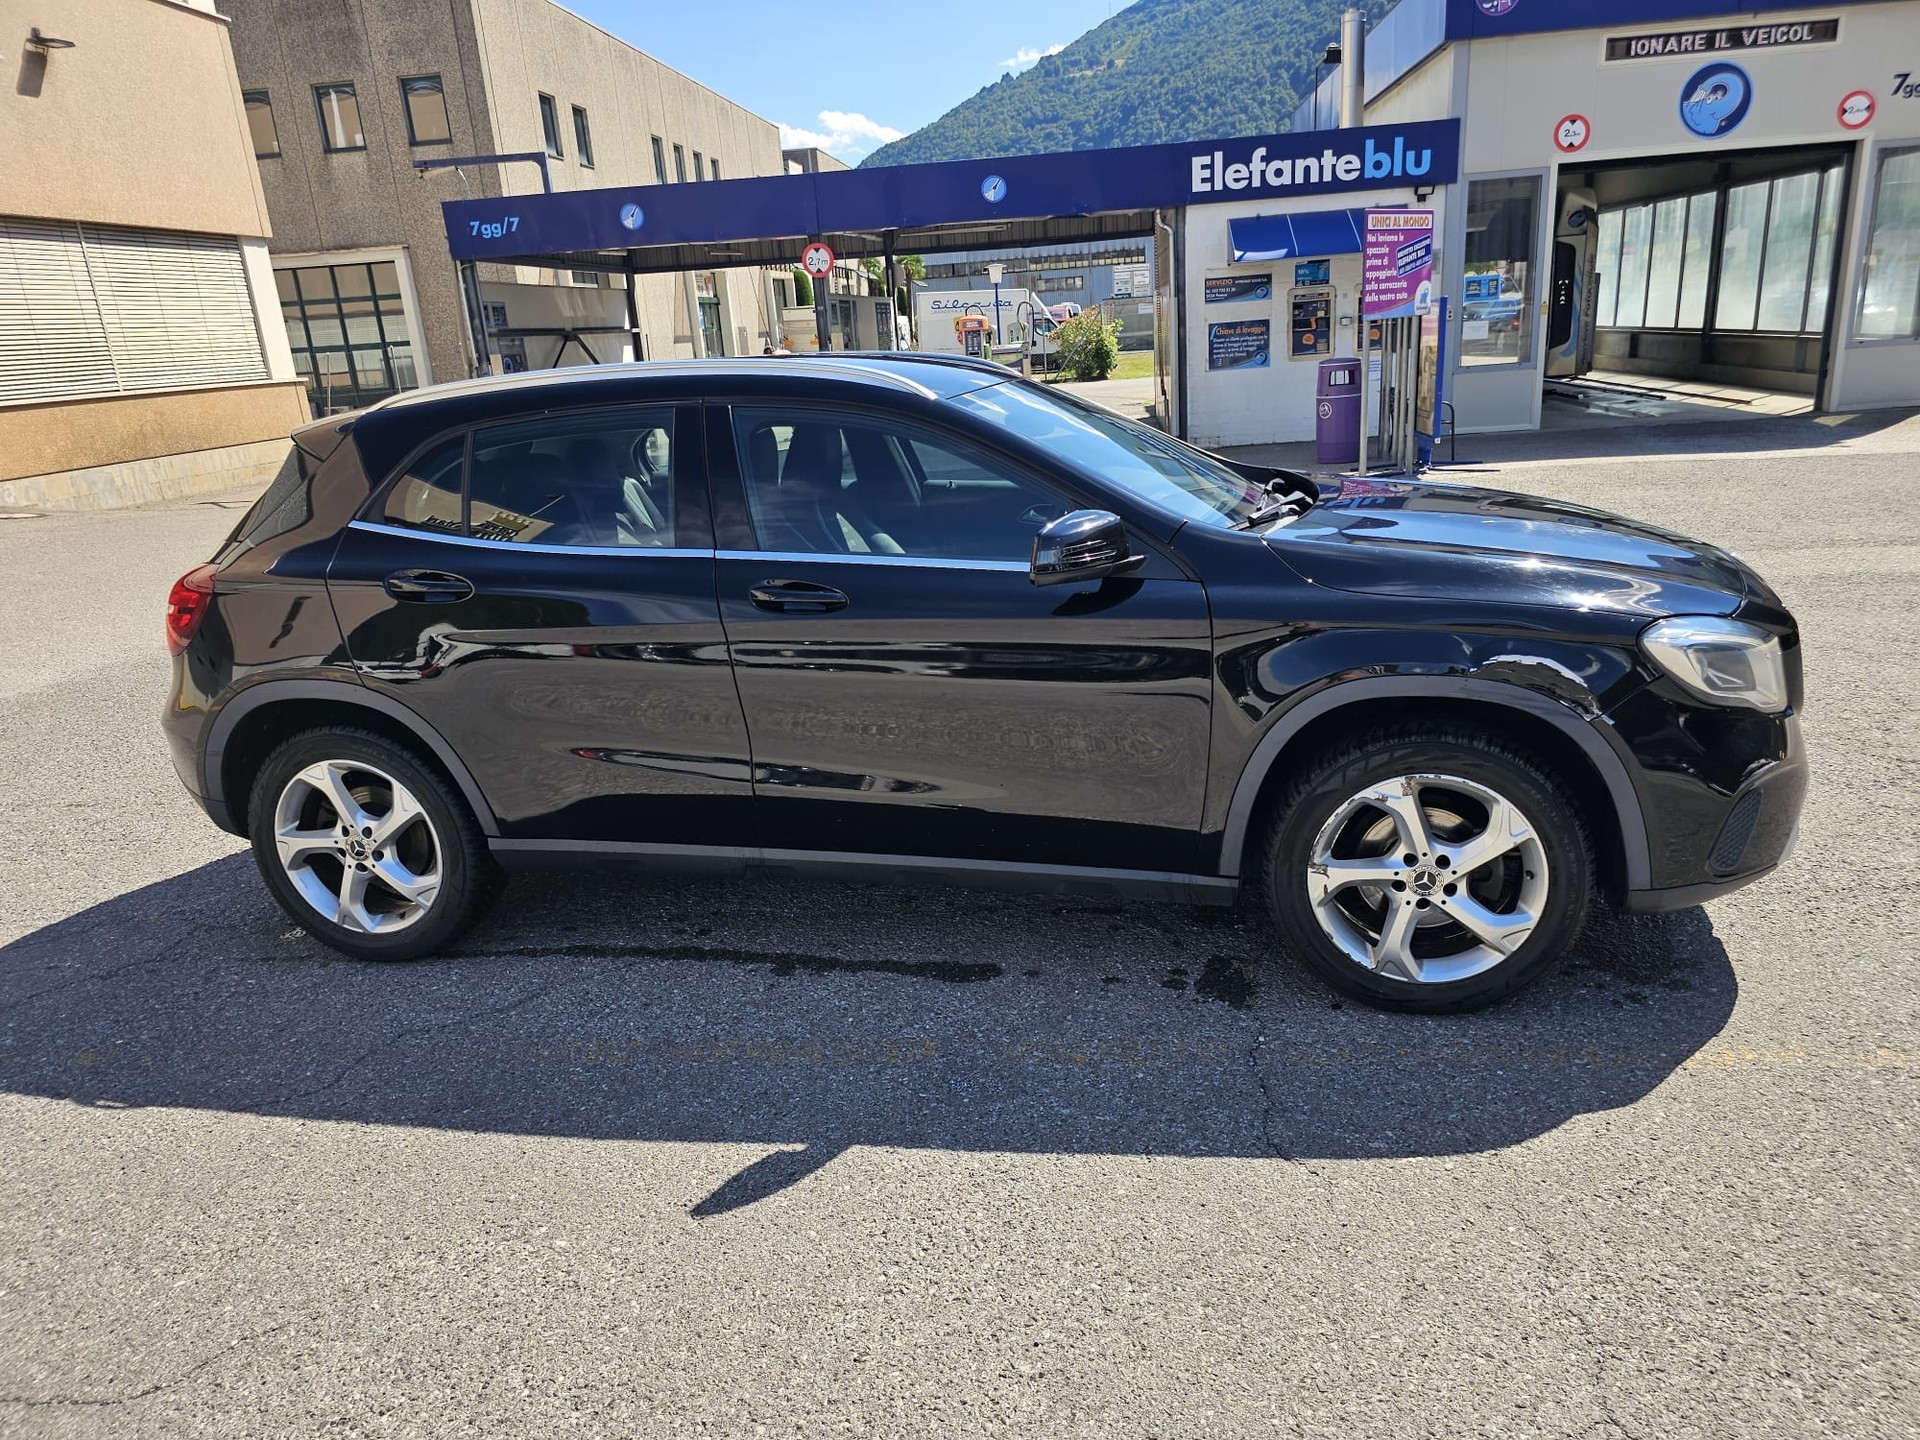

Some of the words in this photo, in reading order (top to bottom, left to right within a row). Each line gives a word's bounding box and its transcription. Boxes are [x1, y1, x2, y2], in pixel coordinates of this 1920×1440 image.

[1630, 34, 1707, 57] IONARE
[1714, 31, 1731, 49] IL
[1742, 24, 1815, 46] VEICOL
[1191, 136, 1432, 193] Elefanteblu
[469, 216, 520, 239] 7gg/7
[1372, 216, 1391, 228] UNICI
[1393, 216, 1401, 227] AL
[1403, 215, 1430, 227] MONDO
[1367, 233, 1377, 242] Noi
[1378, 232, 1398, 242] laviamo
[1366, 244, 1389, 256] spazzole
[1366, 257, 1382, 269] prima
[1383, 256, 1389, 266] di
[1365, 268, 1397, 280] appoggiarle
[1365, 281, 1379, 291] sulla
[1379, 279, 1408, 290] carrozzeria
[1365, 292, 1379, 302] della
[1380, 292, 1395, 301] vostra
[1396, 291, 1408, 300] auto
[1216, 327, 1234, 336] Chiave
[1235, 326, 1241, 334] di
[1242, 325, 1266, 335] lavaggio
